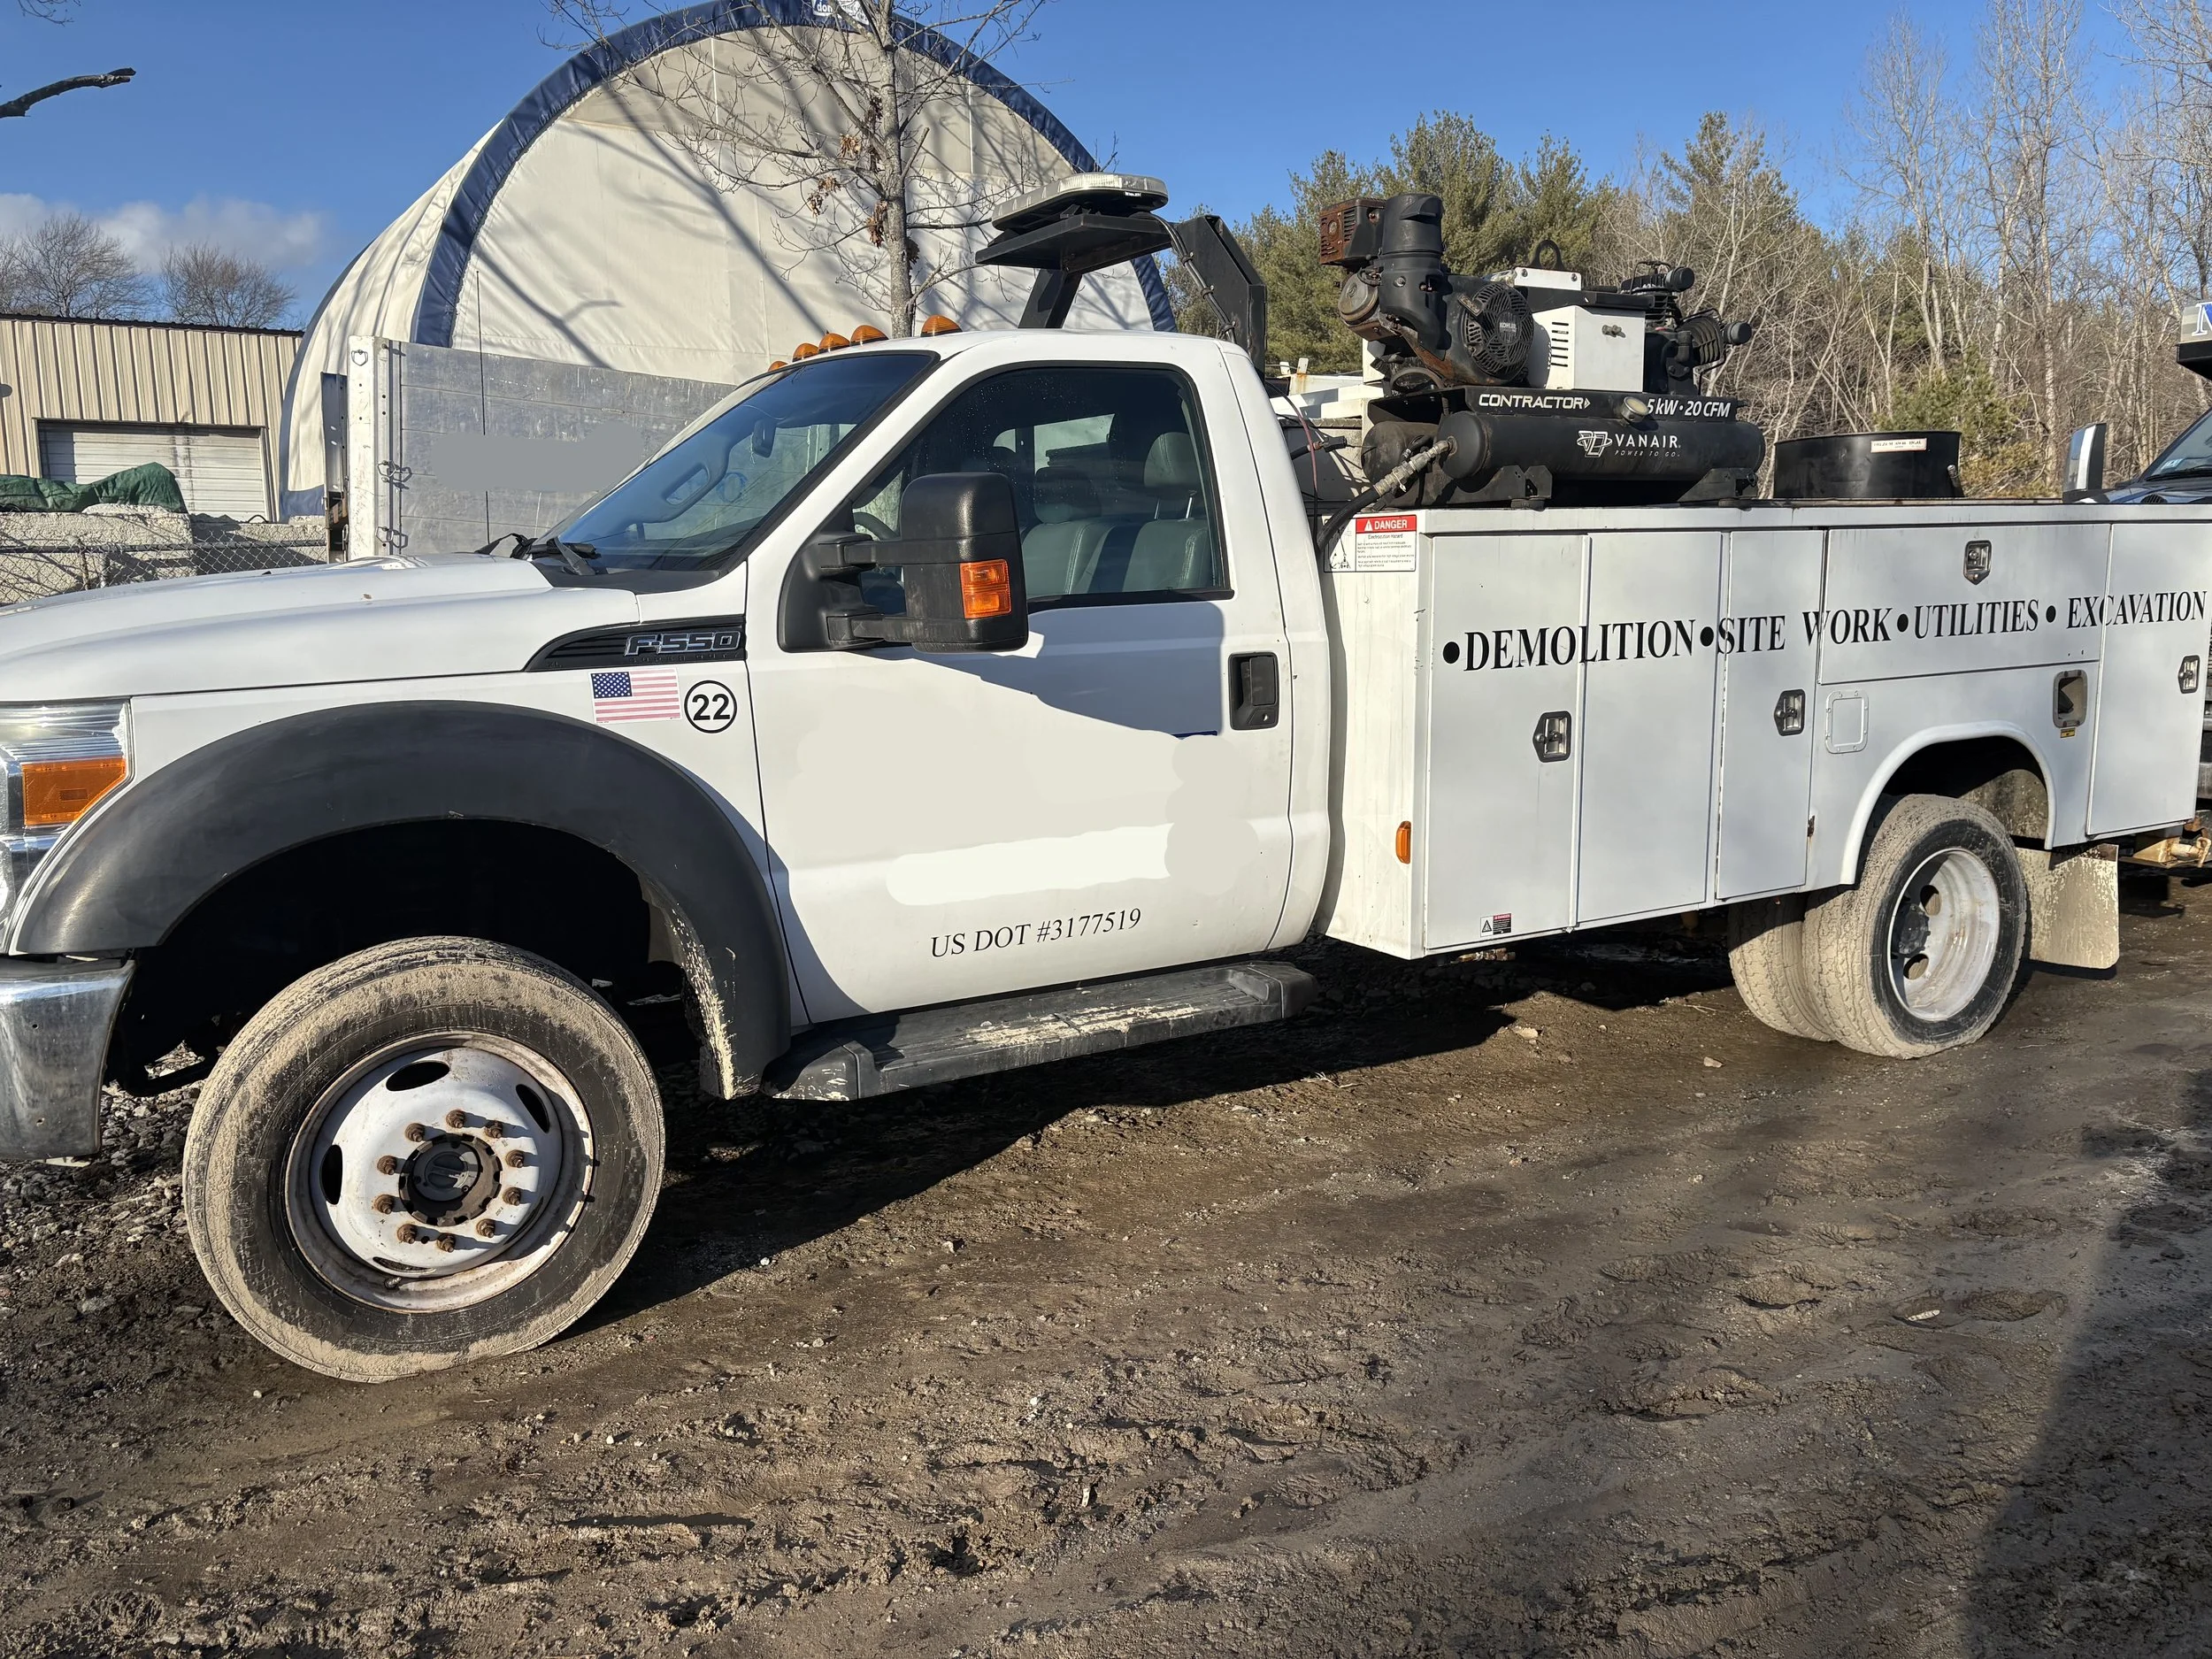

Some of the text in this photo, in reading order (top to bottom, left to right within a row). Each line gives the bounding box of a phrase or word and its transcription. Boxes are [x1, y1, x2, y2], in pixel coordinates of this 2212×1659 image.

[1479, 393, 1584, 410] CONTRACTOR
[1655, 397, 1679, 415] kW
[1684, 400, 1702, 417] 20
[1702, 401, 1732, 418] CFM
[1615, 434, 1678, 449] VANAIR
[1374, 519, 1408, 530] DANGER
[1463, 590, 2208, 672] DEMOLITION SITE WORK UTILITIES EXCAVATION
[692, 694, 731, 721] 22
[931, 908, 1141, 957] US DOT #3177519
